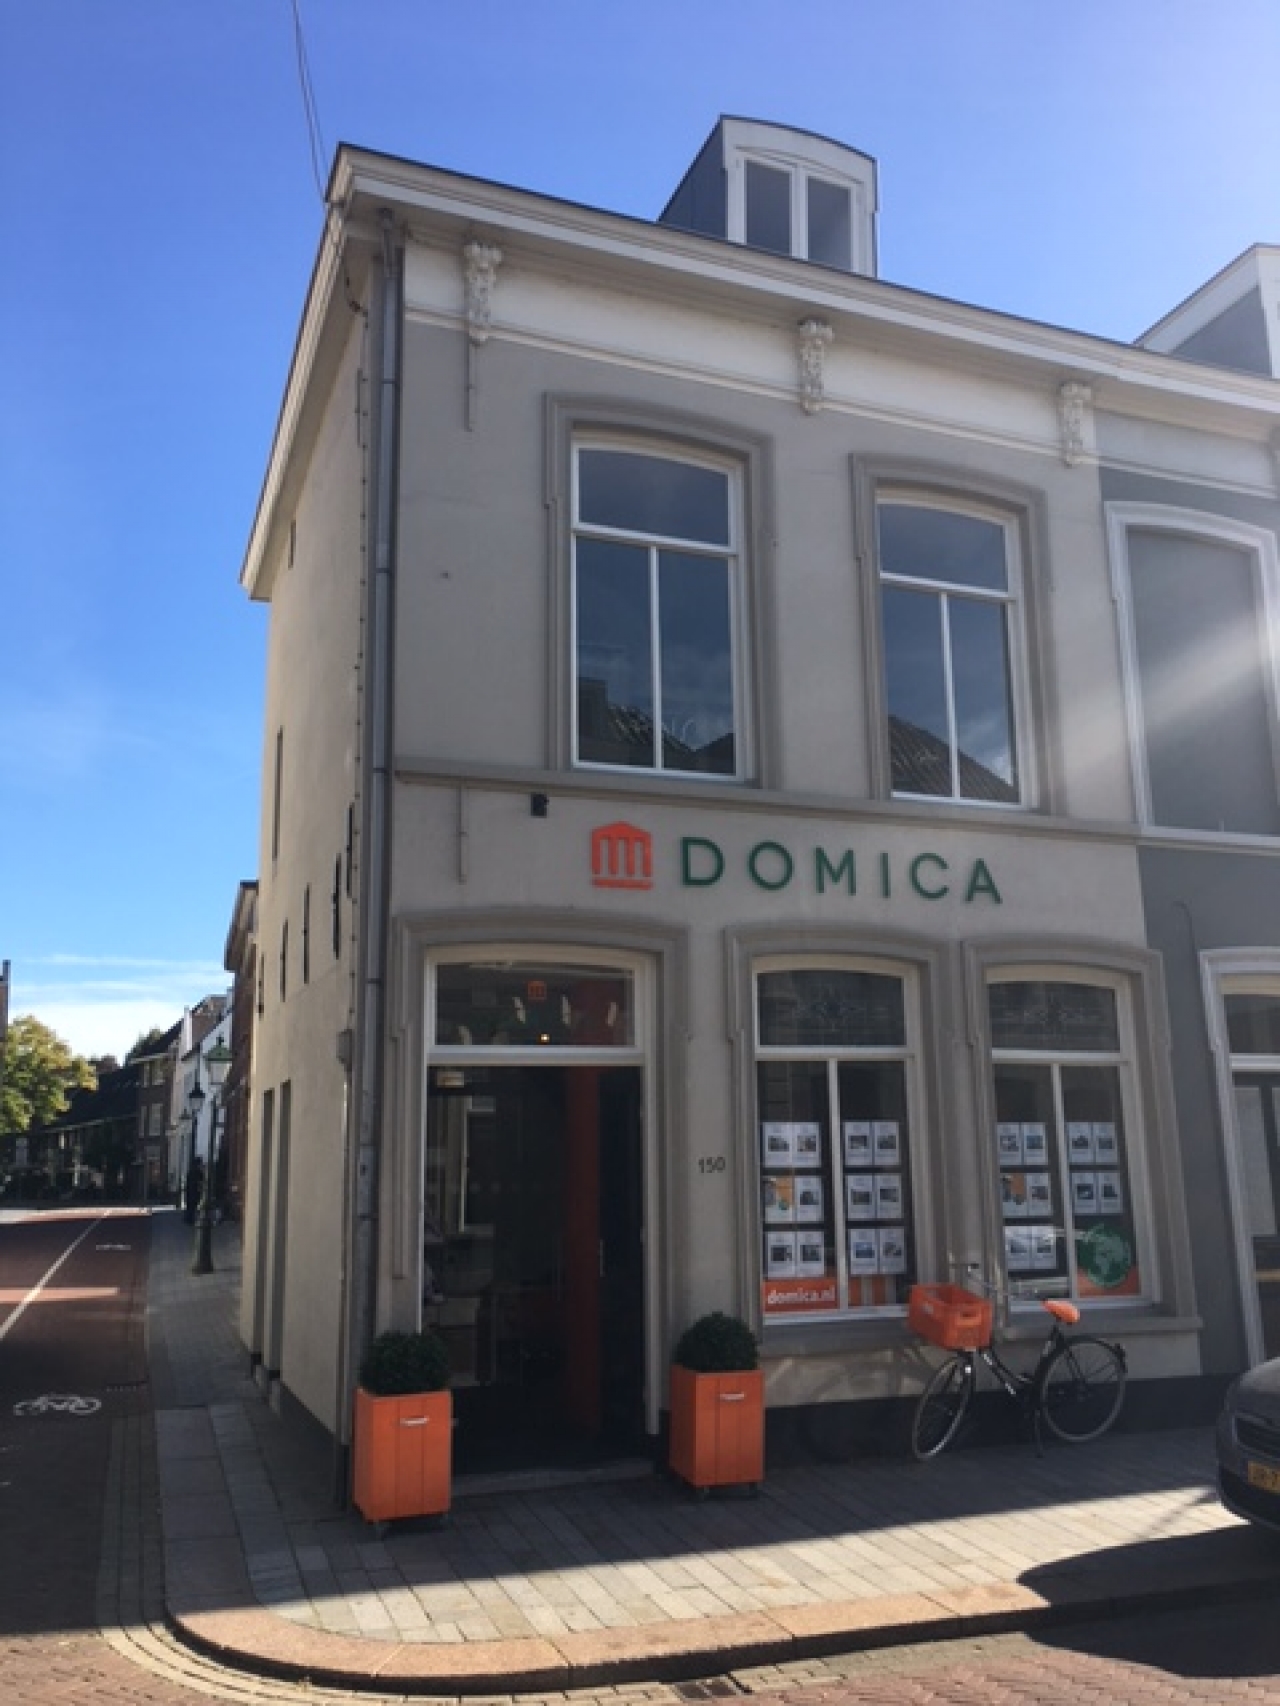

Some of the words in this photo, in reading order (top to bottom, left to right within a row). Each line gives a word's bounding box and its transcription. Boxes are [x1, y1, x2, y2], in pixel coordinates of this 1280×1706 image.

[680, 836, 1002, 904] DOMICA
[698, 1157, 726, 1174] 150
[767, 1285, 836, 1305] domica.nl
